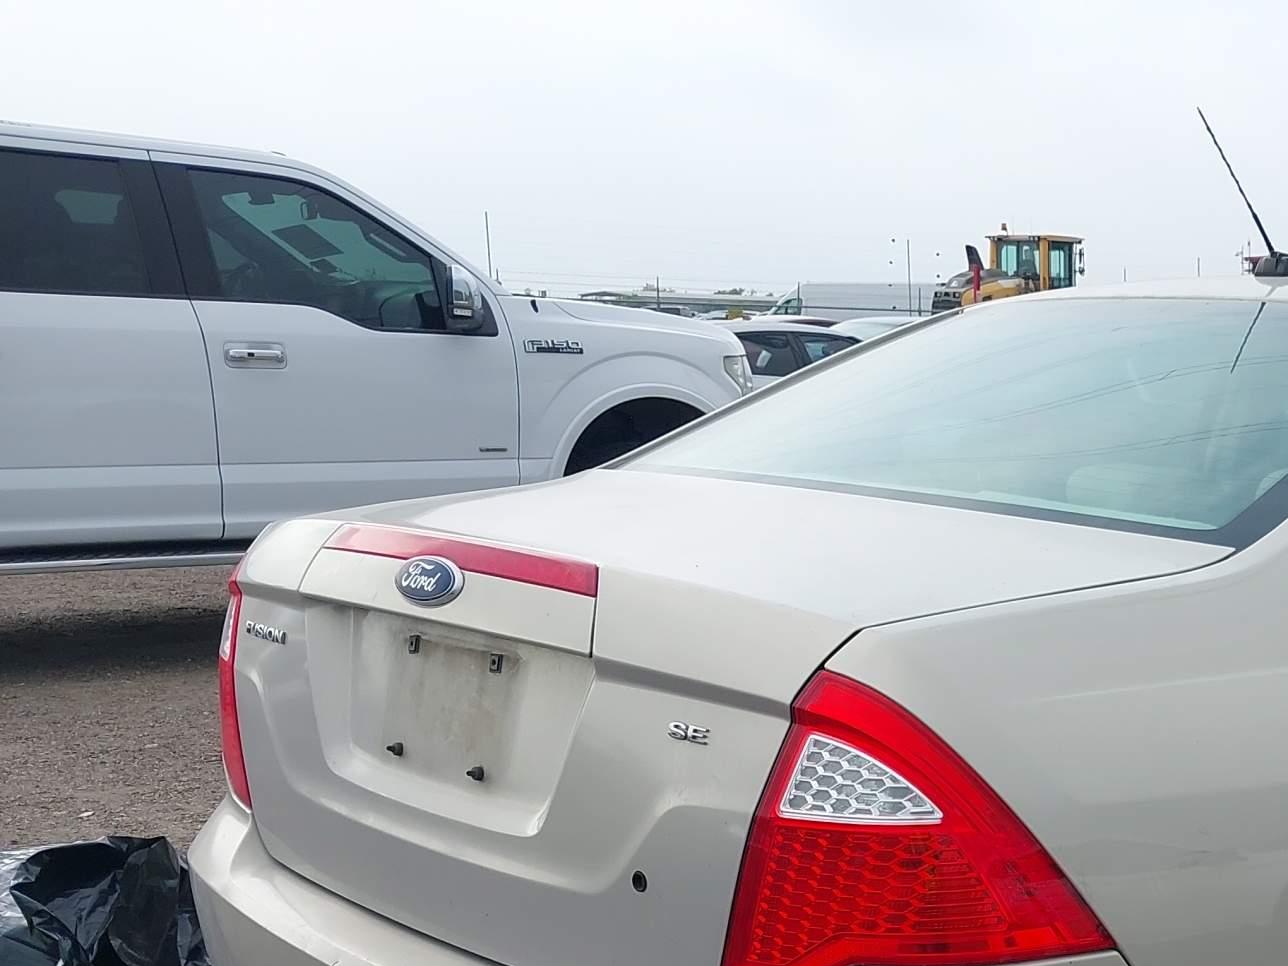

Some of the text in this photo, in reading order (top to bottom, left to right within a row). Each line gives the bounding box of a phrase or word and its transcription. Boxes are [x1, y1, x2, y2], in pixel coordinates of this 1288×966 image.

[401, 561, 441, 592] Ford
[246, 620, 287, 645] FUSION
[668, 721, 710, 745] SE
